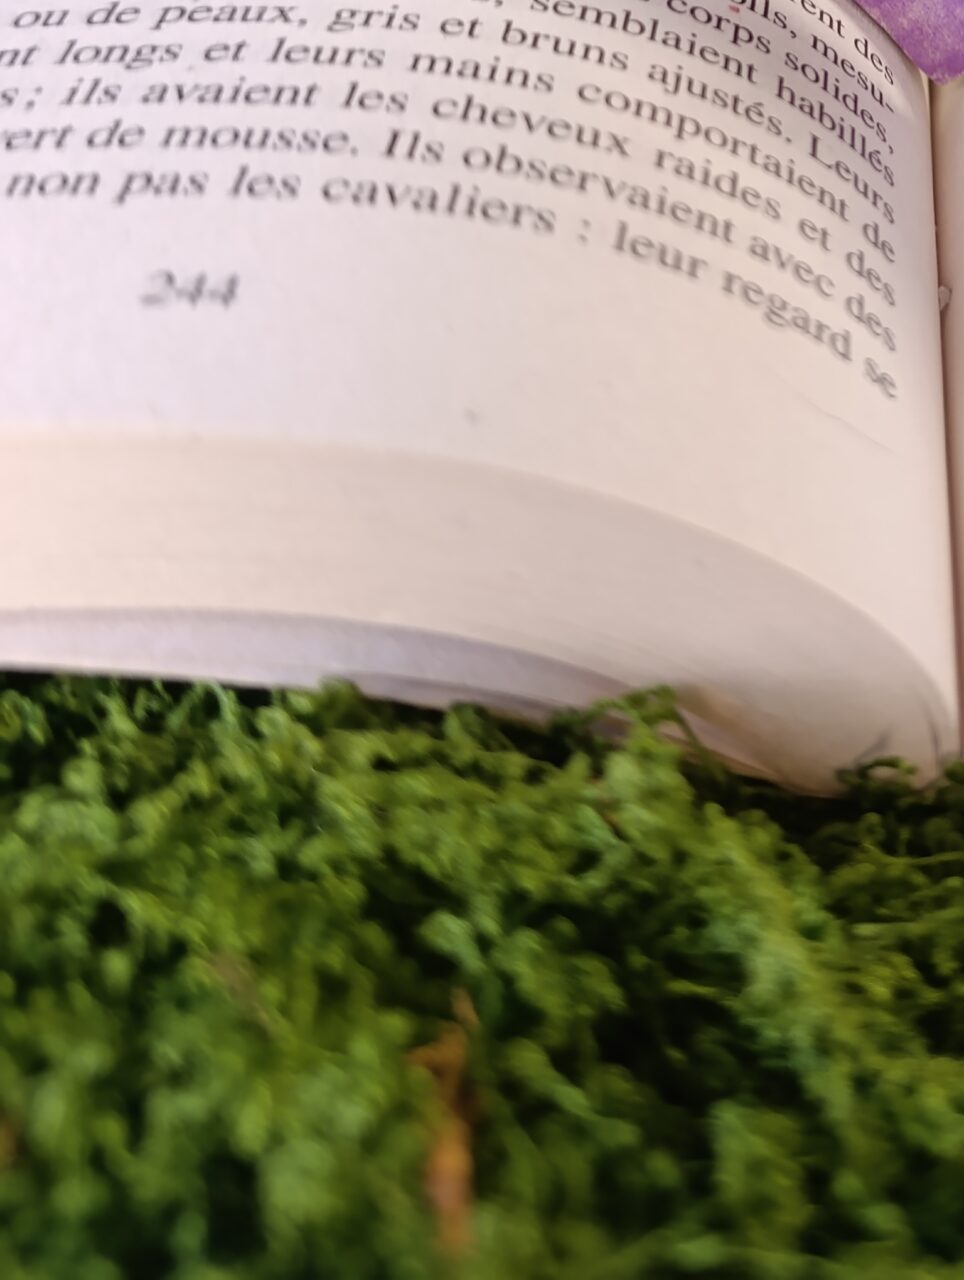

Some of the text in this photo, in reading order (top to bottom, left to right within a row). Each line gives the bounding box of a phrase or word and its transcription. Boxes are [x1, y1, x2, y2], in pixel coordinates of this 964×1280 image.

[11, 0, 895, 225] ou de peaux, gris et bruns ajustés. Leurs
[53, 36, 896, 264] longs et leurs mains comportaient de
[776, 75, 895, 188] habillés
[783, 49, 895, 156] solides,
[810, 31, 895, 114] mesu-
[853, 36, 895, 87] des
[5, 163, 898, 400] non pas les cavaliers leur regard se
[59, 74, 896, 307] ils avaient les cheveux raides et des
[85, 118, 896, 353] de mousse. Ils observaient avec des
